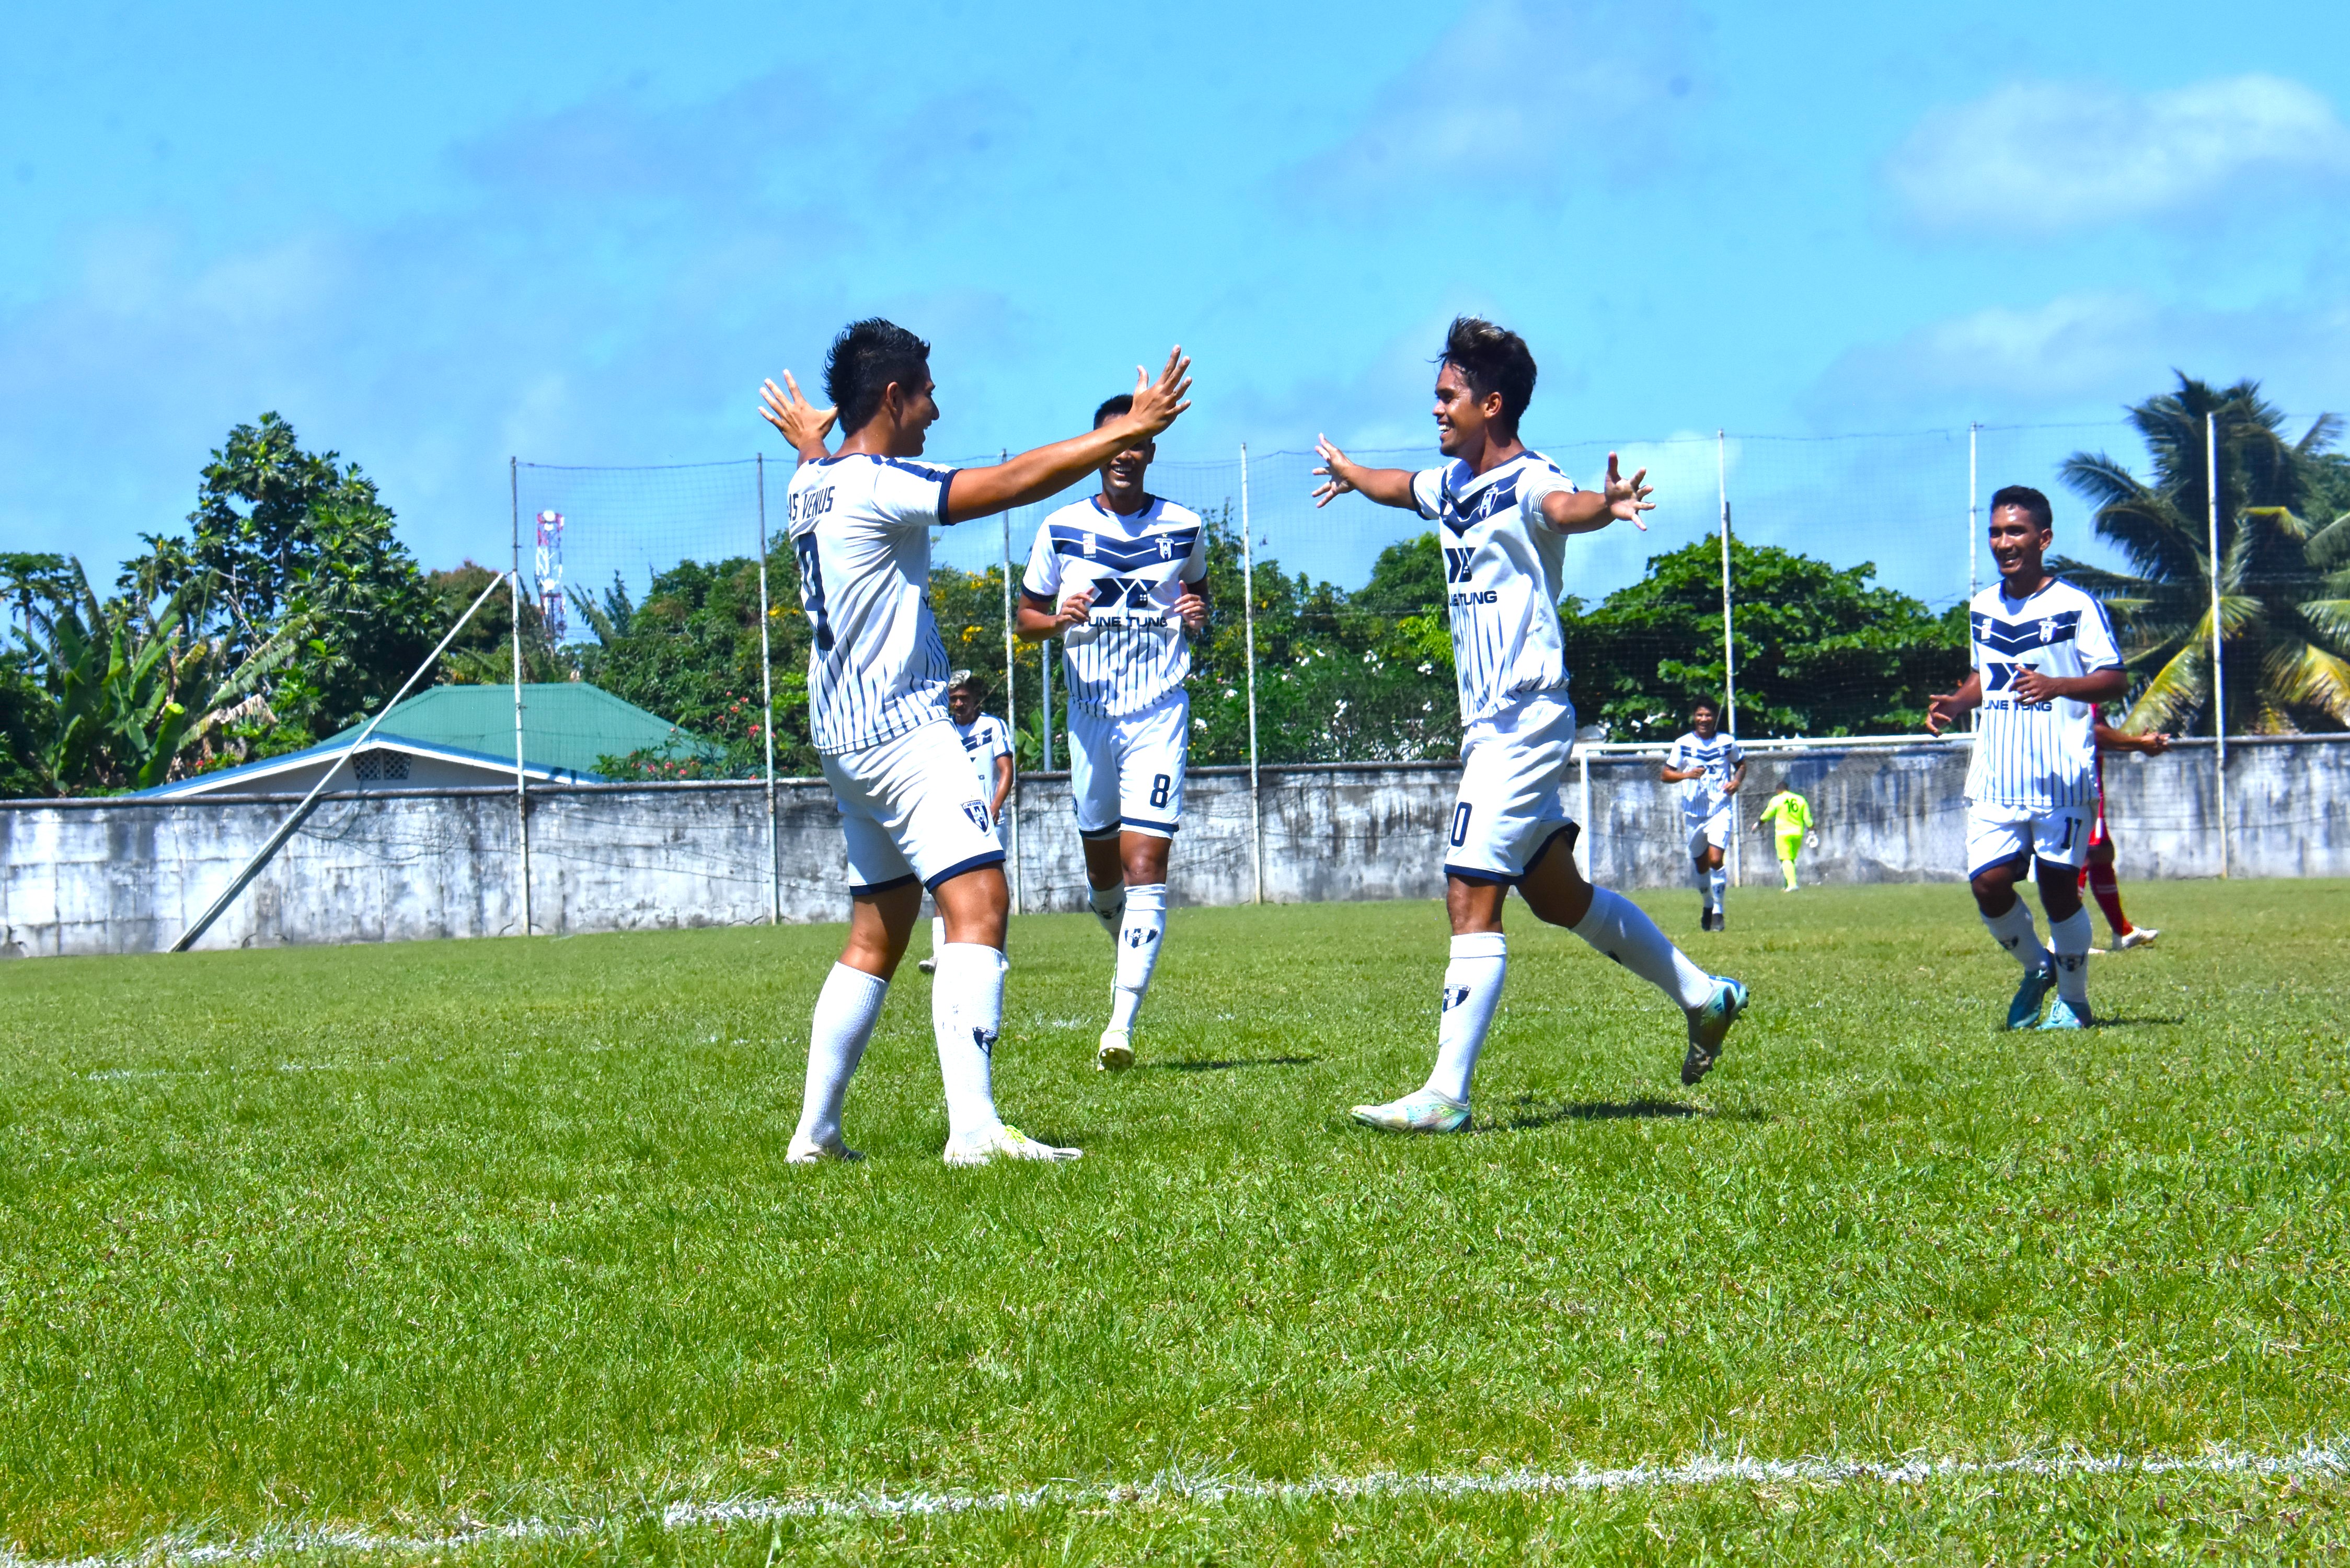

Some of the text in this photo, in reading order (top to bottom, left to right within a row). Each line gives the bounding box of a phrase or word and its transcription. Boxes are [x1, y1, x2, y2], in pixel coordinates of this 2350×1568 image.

[802, 486, 835, 520] VENUS
[1458, 590, 1497, 606] TUNG
[1126, 616, 1168, 628] TUNG
[1983, 699, 2009, 710] UNE
[1150, 774, 1171, 809] 8
[1783, 798, 1799, 812] 16
